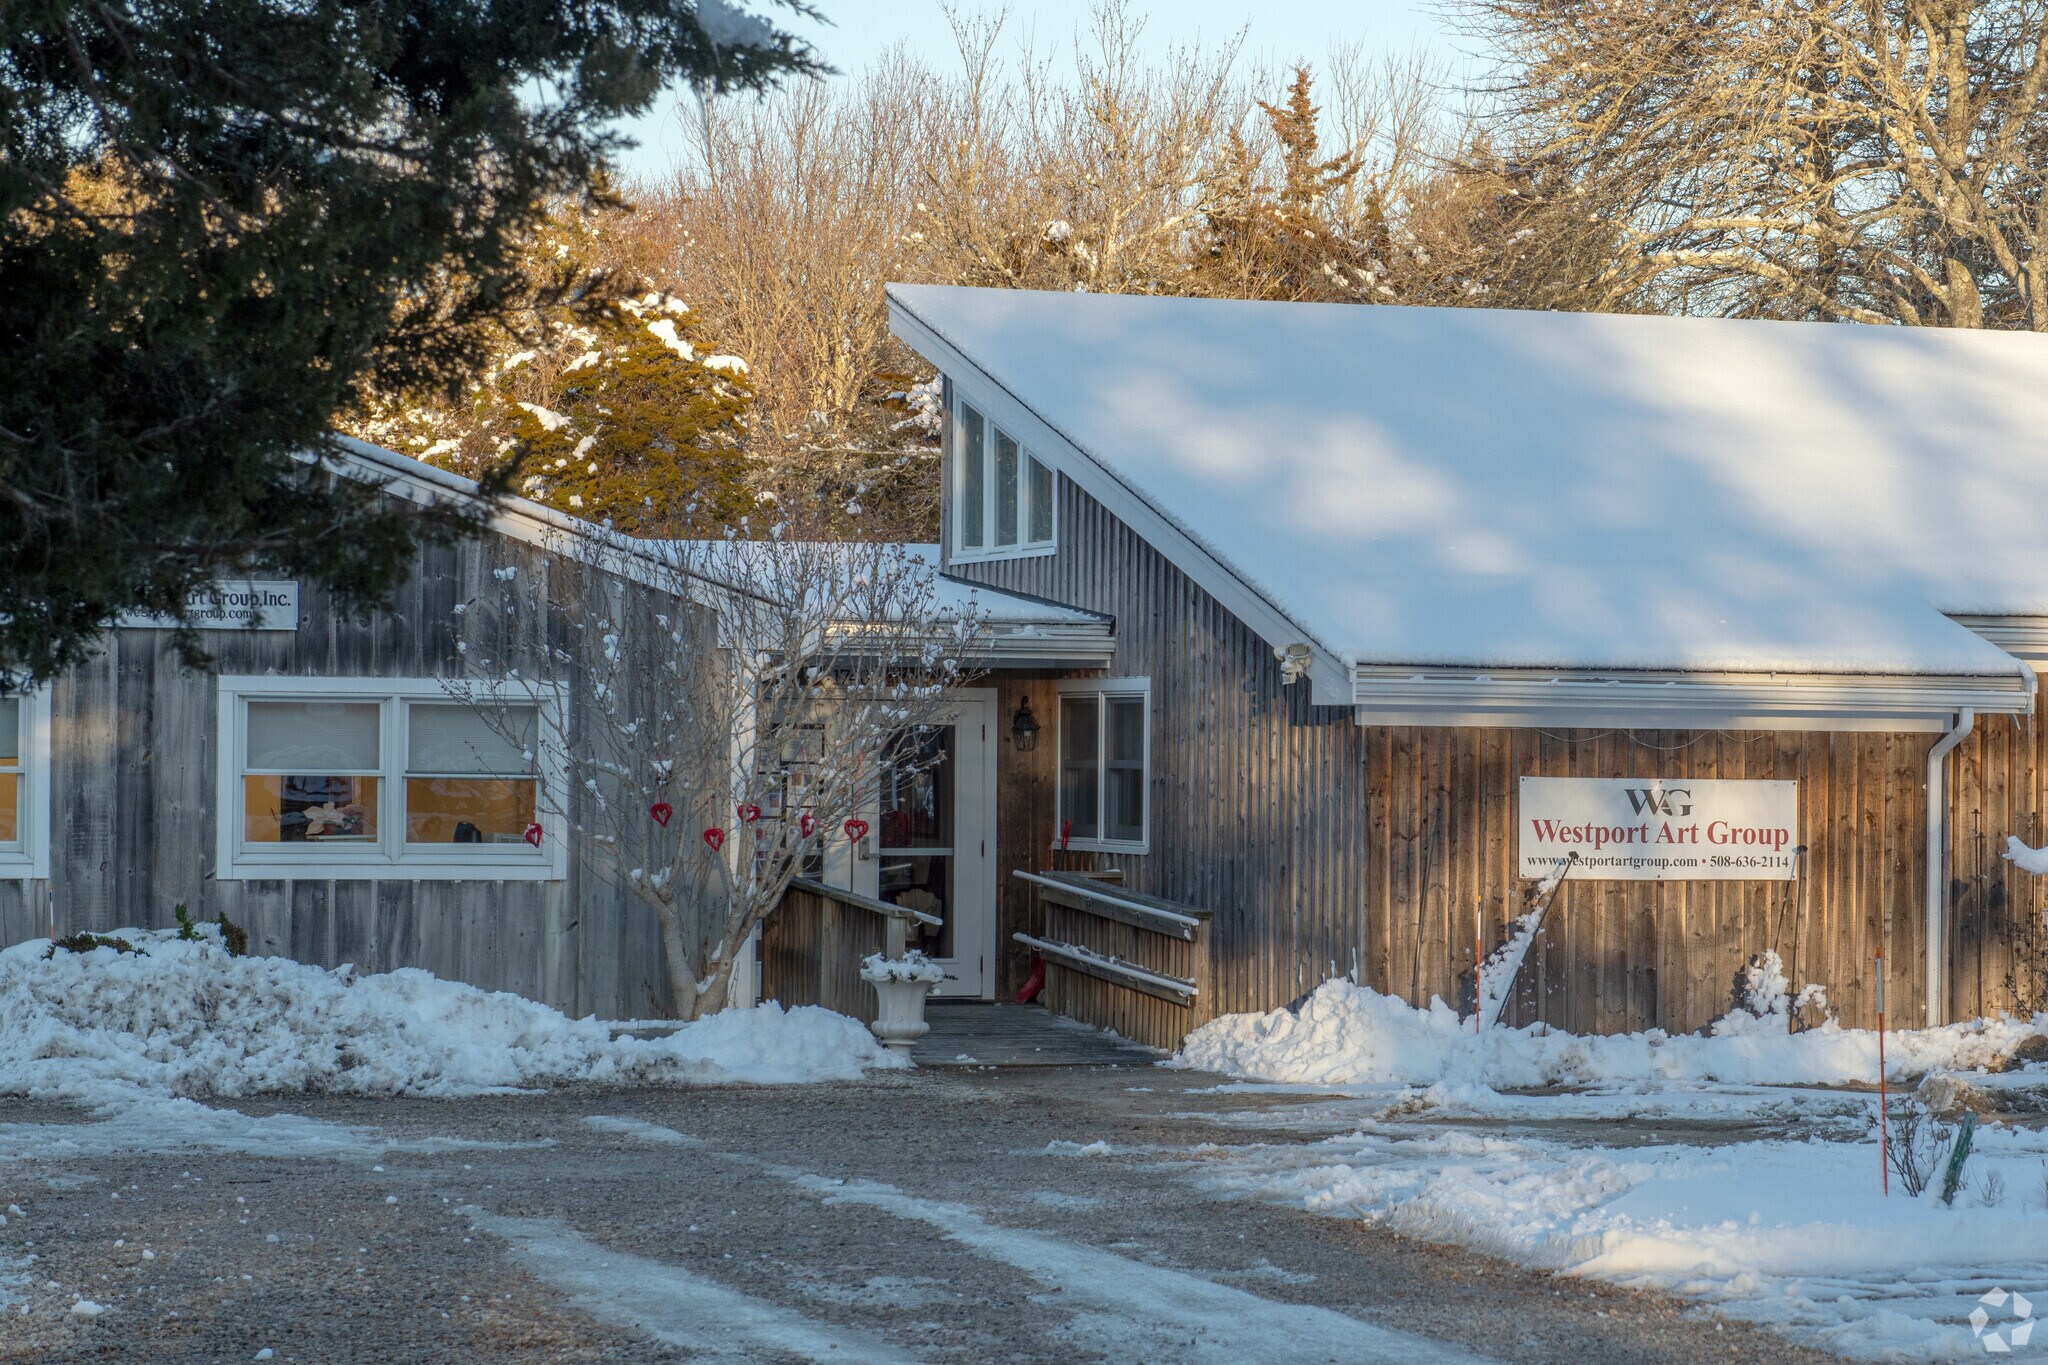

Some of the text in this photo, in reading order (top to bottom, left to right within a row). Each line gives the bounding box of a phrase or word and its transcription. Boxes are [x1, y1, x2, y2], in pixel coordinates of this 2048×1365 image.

[185, 590, 206, 605] rt
[1531, 819, 1789, 851] Westport Art Group
[1709, 855, 1789, 868] 508-636-2114
